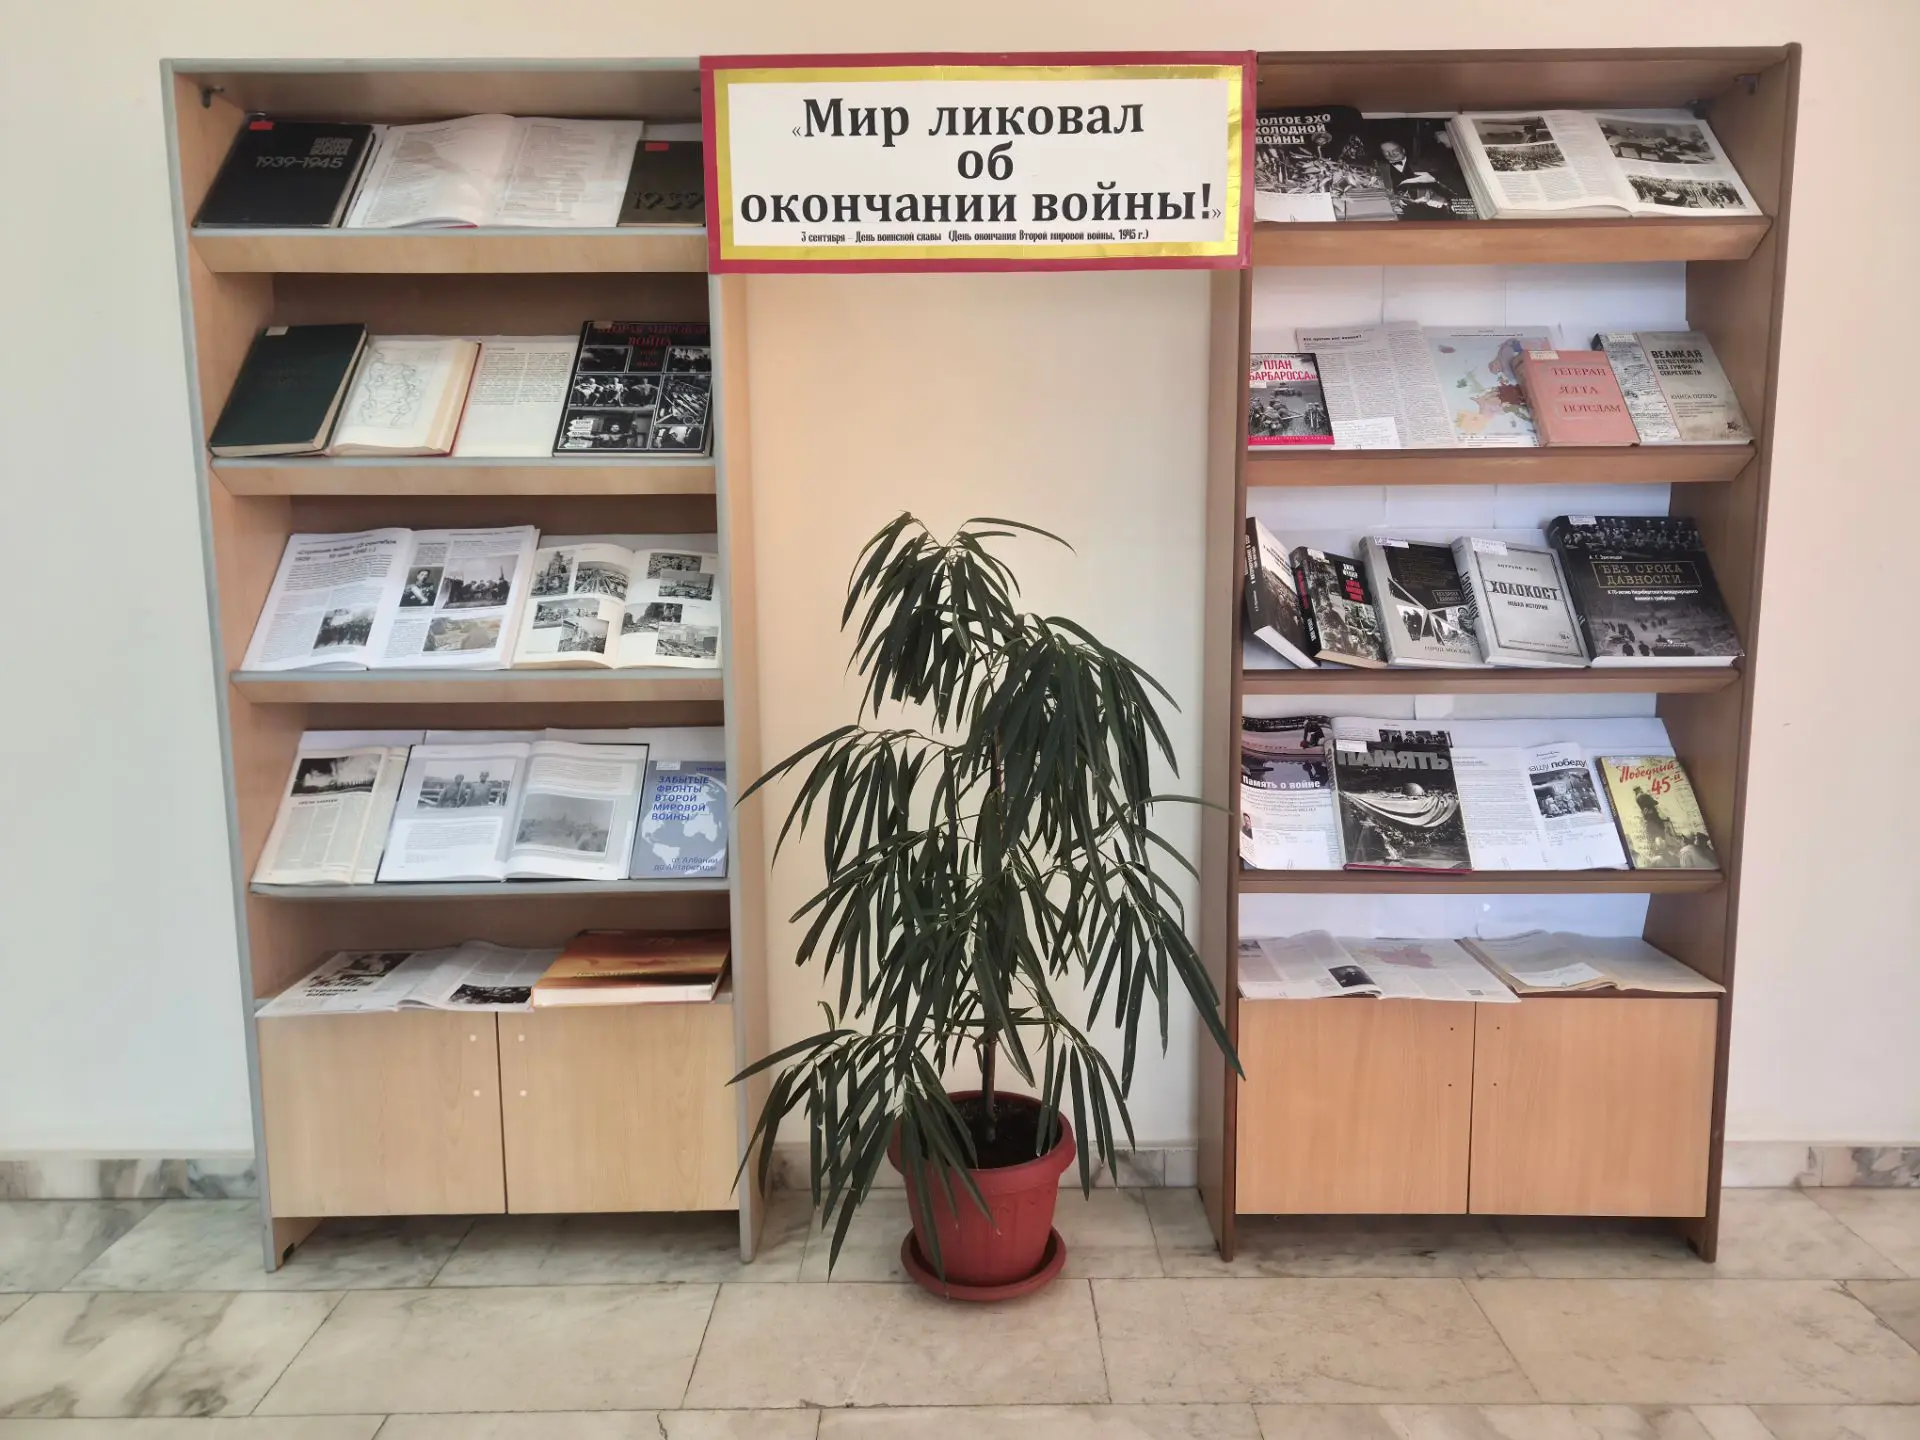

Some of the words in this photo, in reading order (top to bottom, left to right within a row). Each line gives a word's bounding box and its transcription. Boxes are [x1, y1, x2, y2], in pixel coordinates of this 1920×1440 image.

[792, 97, 909, 147] «Мир
[928, 103, 1144, 136] ликовал
[1305, 114, 1331, 124] ЭХО
[957, 141, 1014, 180] об
[740, 192, 1019, 223] окончании
[1031, 181, 1222, 221] войны!»
[801, 231, 807, 242] 3
[808, 232, 846, 244] сентября
[854, 230, 876, 243] День
[877, 230, 915, 242] воинской
[916, 230, 942, 242] славы
[948, 230, 972, 242] (День
[974, 231, 1016, 242] окончания
[1018, 229, 1048, 242] Второй
[1050, 230, 1084, 242] мировой
[1086, 230, 1116, 242] войны,
[1118, 229, 1136, 240] 1945
[1651, 350, 1703, 359] ВЕЛИКАЯ
[1263, 360, 1292, 370] ПЛАН
[1552, 367, 1606, 376] ТЕГЕРАН
[1559, 384, 1599, 394] ЯЛТА
[1563, 403, 1621, 414] ПОТСДАМ
[1602, 564, 1630, 574] БЕЗ
[1636, 564, 1684, 574] СРОКА
[1490, 580, 1560, 600] ХОЛОКОСТ
[1336, 750, 1450, 770] ПАМЯТЬ
[1550, 758, 1587, 768] победу
[1617, 760, 1676, 783] Победный
[658, 776, 710, 784] ЗАБЫТЫЕ
[1651, 771, 1684, 795] 45-й
[656, 784, 702, 793] ФРОНТЫ
[655, 794, 697, 802] ВТОРОЙ
[653, 802, 706, 812] МИРОВОЙ
[652, 812, 690, 821] ВОЙНЫ
